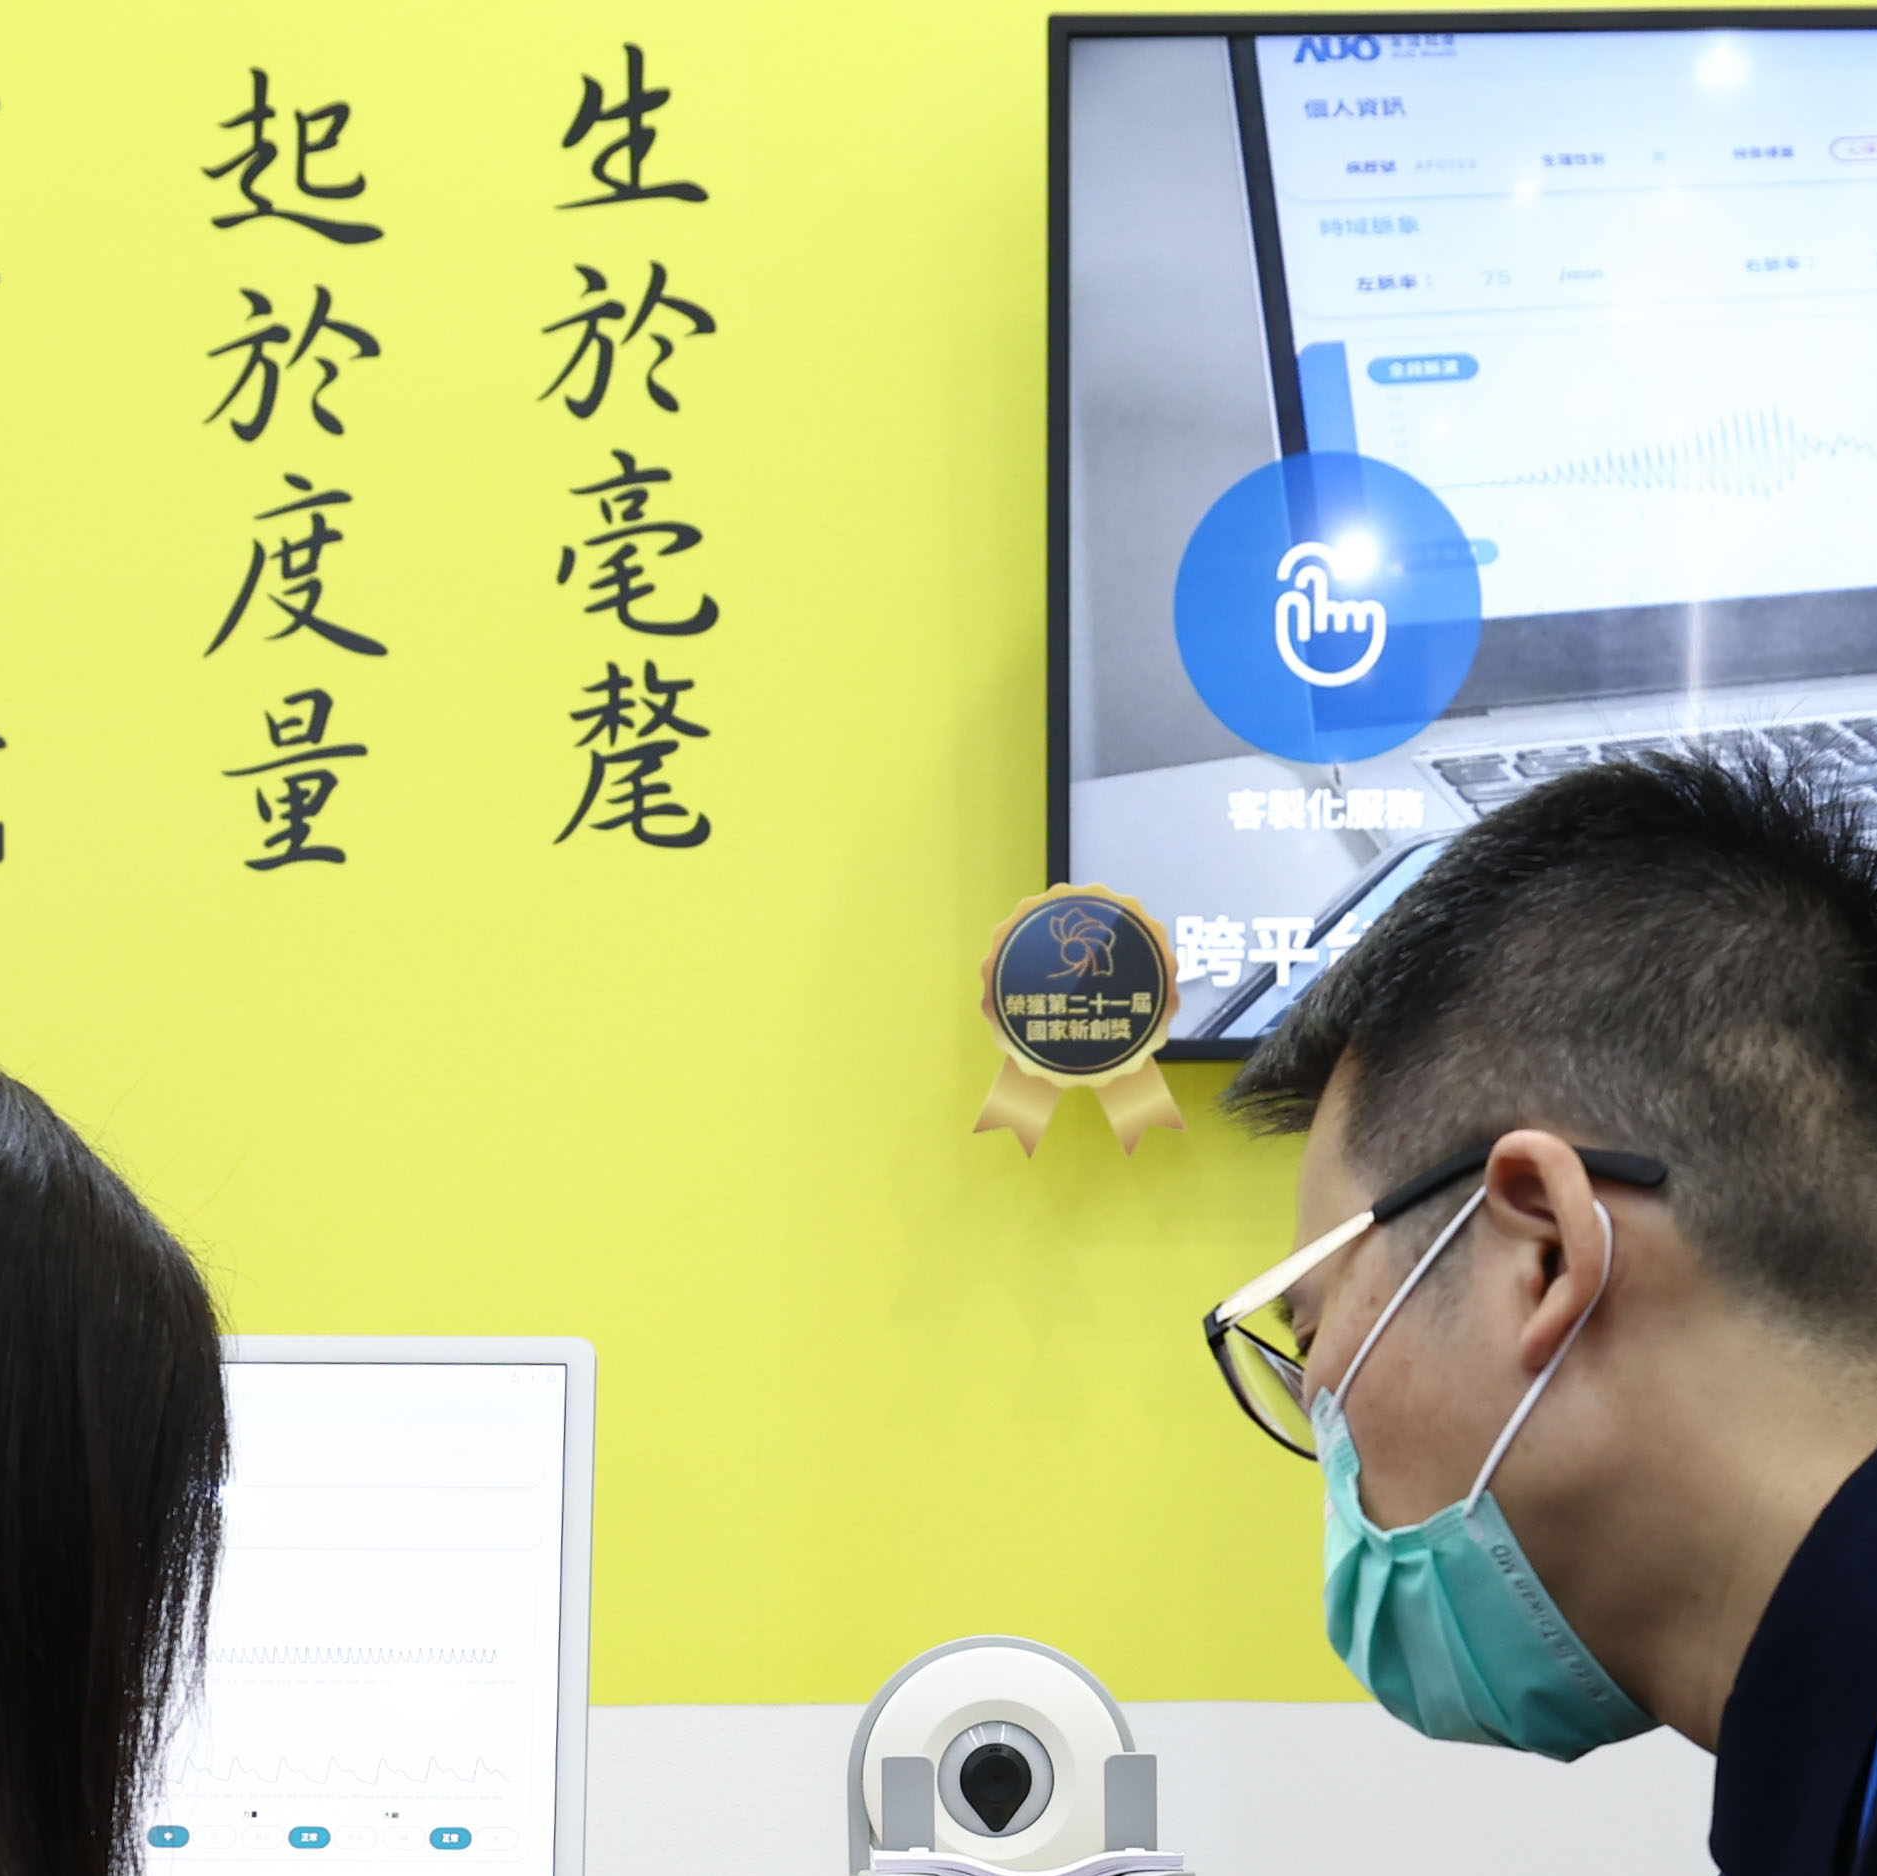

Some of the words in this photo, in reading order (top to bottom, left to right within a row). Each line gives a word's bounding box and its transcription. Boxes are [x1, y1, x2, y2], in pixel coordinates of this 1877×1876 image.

[1303, 96, 1408, 119] 個人資訊
[201, 66, 390, 871] 起於度量
[1227, 788, 1425, 831] 客製化服務
[1004, 991, 1153, 1016] 榮獲第二十一屆
[1026, 1017, 1132, 1042] 國家新創獎
